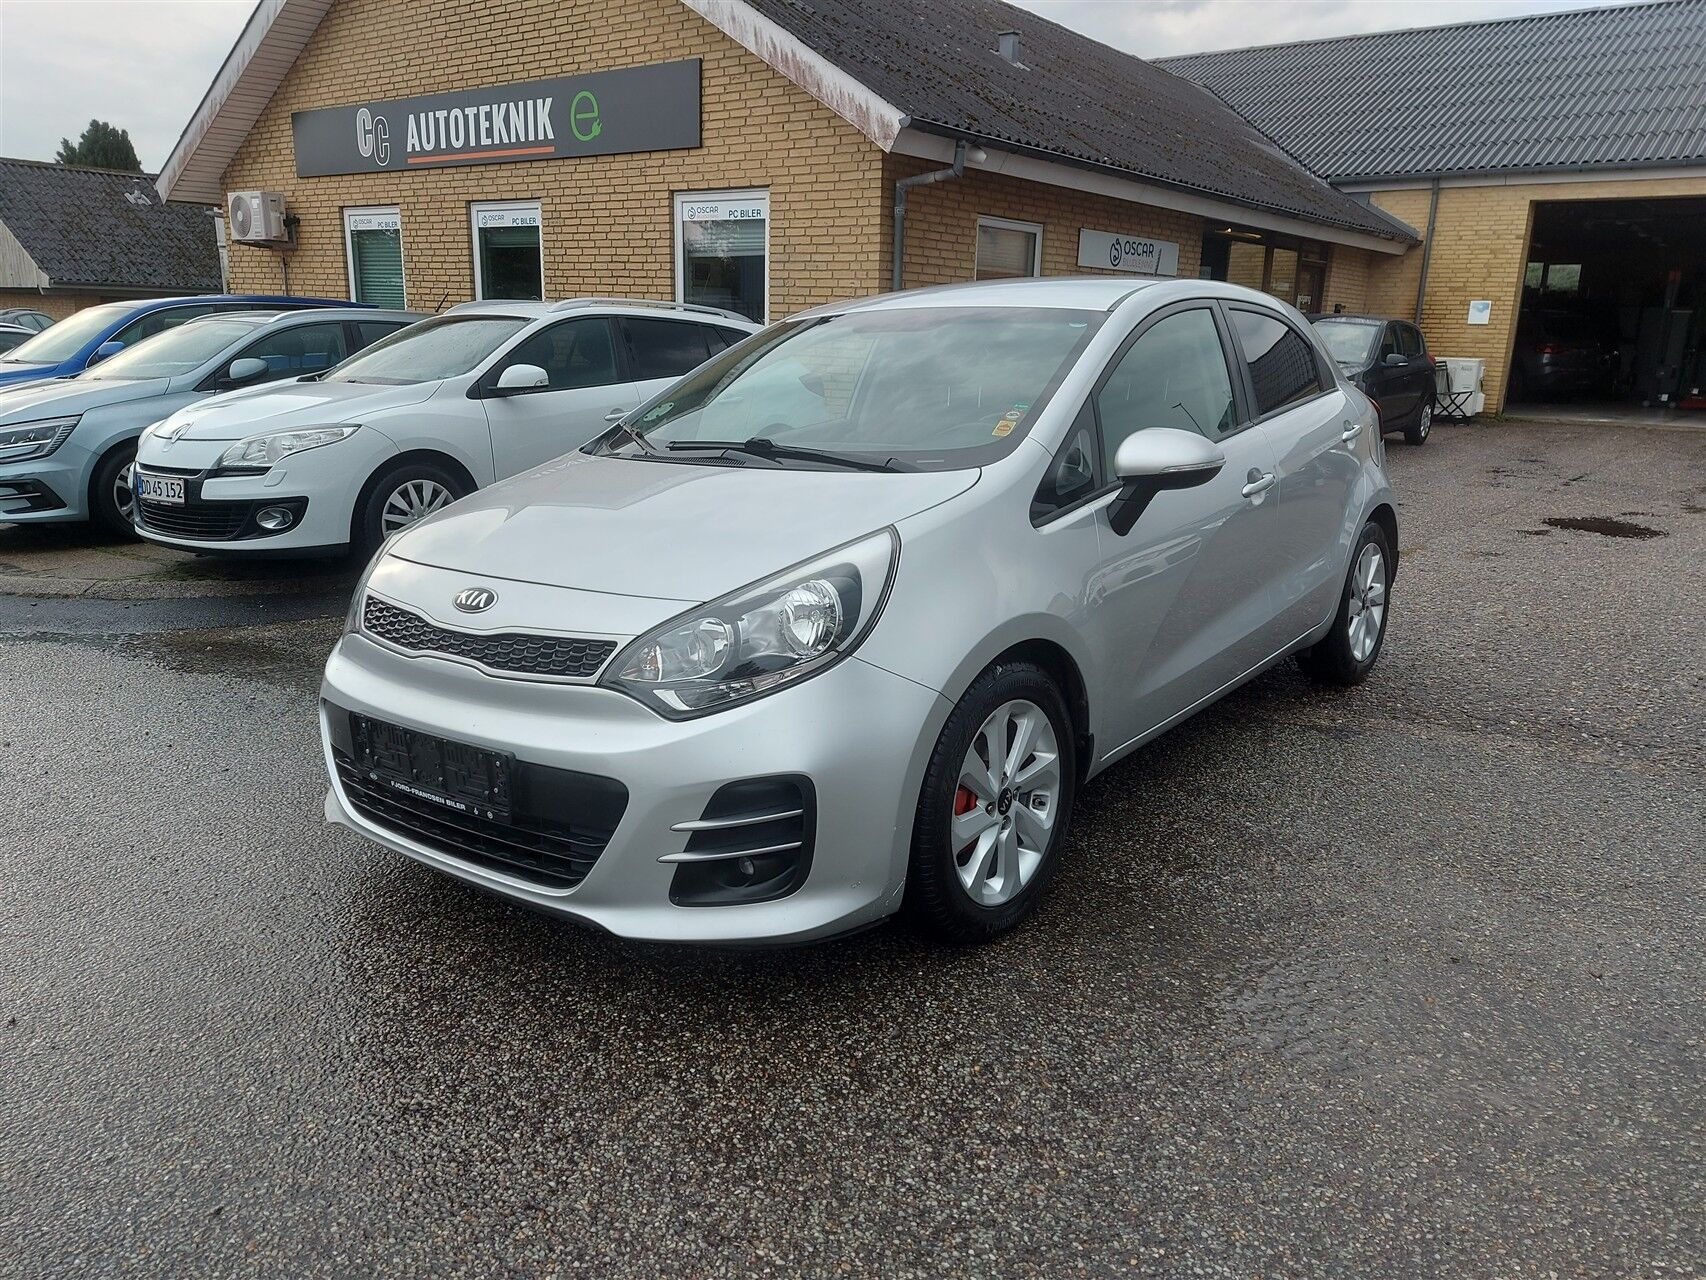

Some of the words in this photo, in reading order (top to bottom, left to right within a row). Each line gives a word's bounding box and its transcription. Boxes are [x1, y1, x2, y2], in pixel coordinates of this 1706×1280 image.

[406, 97, 555, 153] AUTOTEKNIK
[488, 214, 505, 222] OSCAR
[511, 217, 520, 226] PC
[520, 216, 537, 225] BILER
[696, 205, 719, 214] OSCAR
[728, 209, 739, 219] PC
[740, 208, 762, 218] BILER
[358, 218, 373, 226] OSCAR
[377, 221, 385, 229] PC
[385, 220, 398, 229] BILER
[1123, 240, 1155, 258] OSCAR
[152, 480, 163, 497] 45
[164, 482, 183, 499] 152
[455, 590, 489, 608] KIA
[445, 799, 466, 811] BILER
